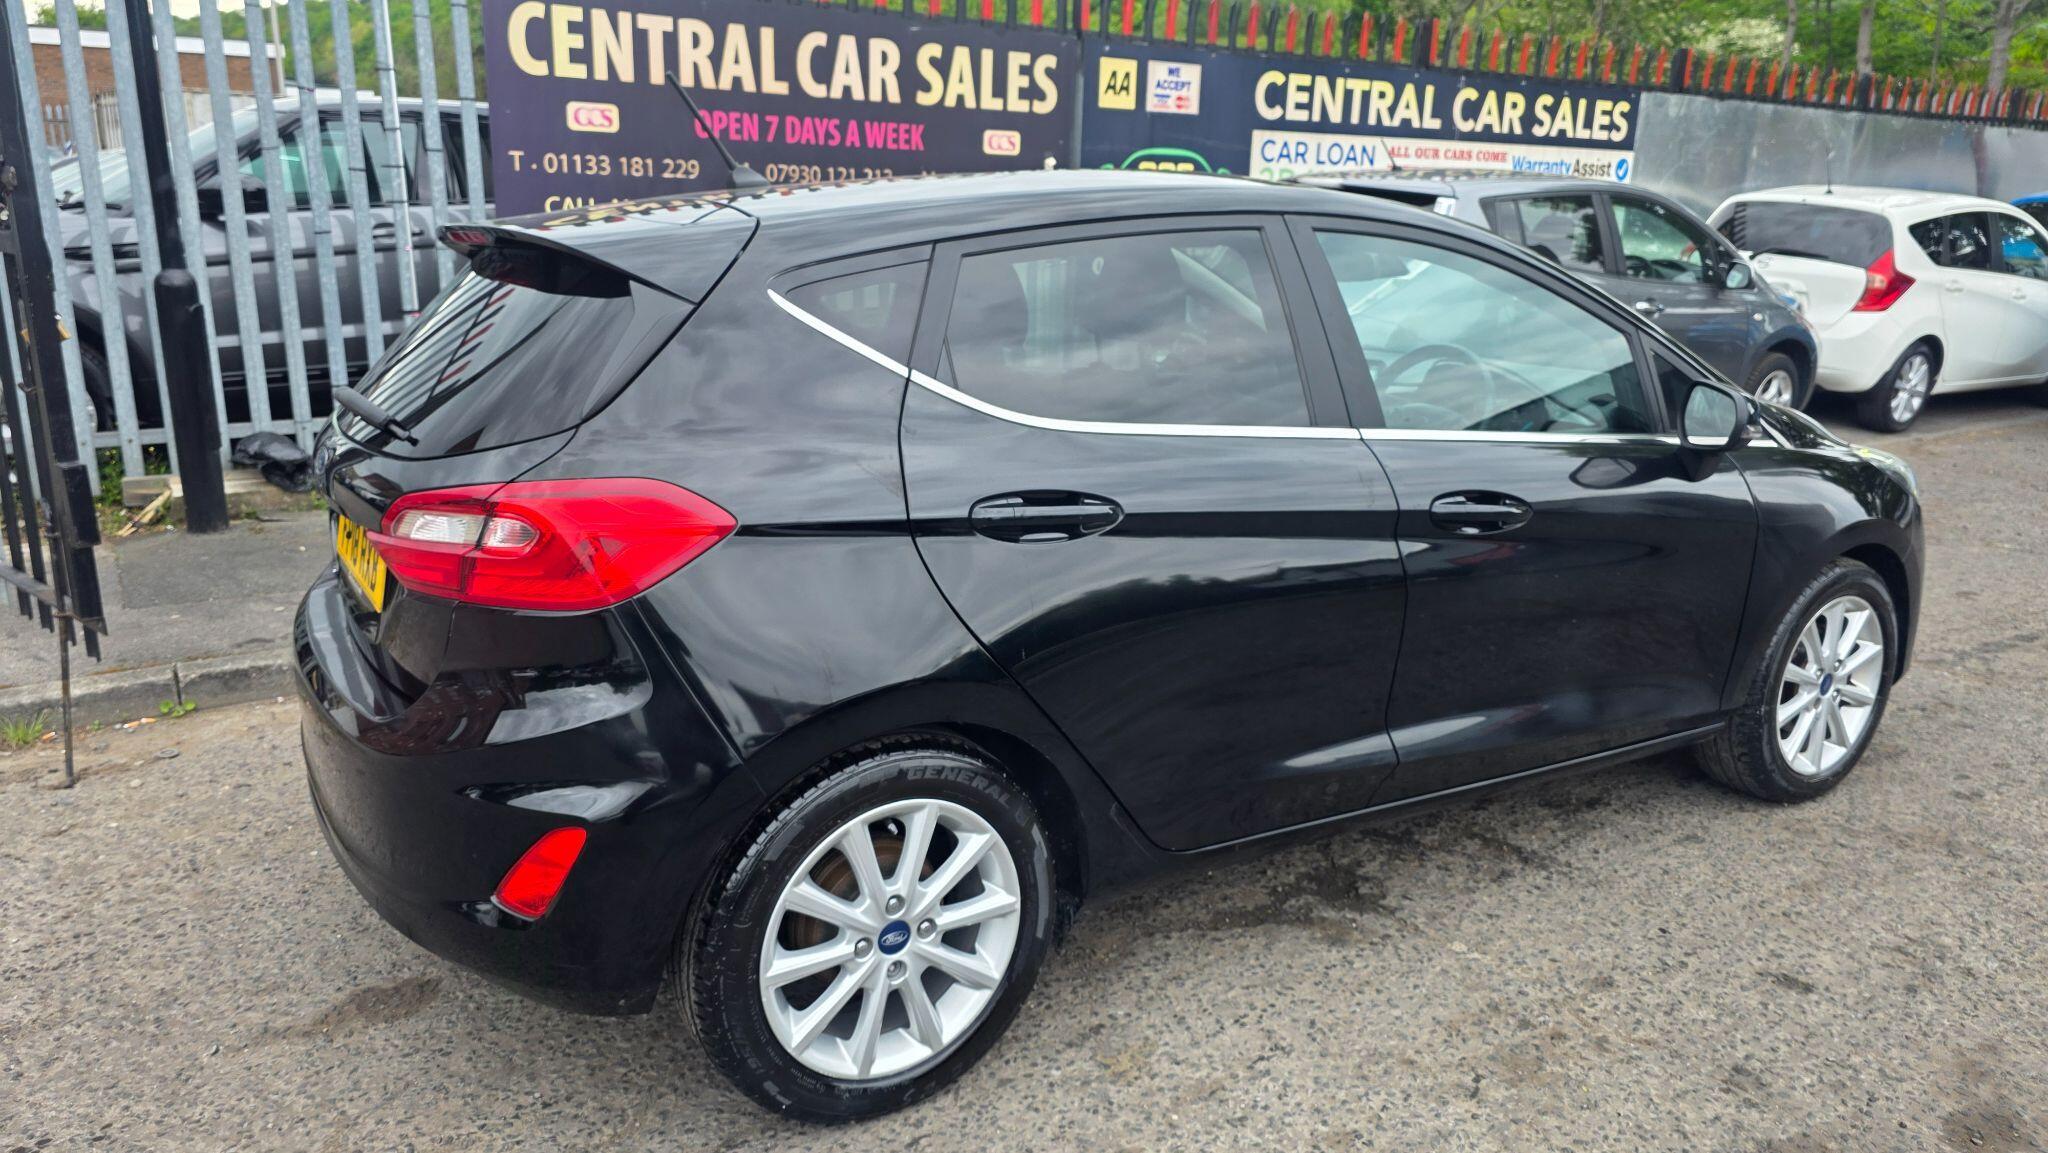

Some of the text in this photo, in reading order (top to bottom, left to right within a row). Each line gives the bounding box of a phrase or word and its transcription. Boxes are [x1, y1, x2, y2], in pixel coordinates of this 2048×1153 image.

[507, 1, 1059, 115] CENTRAL CAR SALES
[1104, 70, 1131, 96] AA
[1155, 80, 1191, 92] ACCEPT
[1254, 70, 1632, 142] CENTRAL CAR SALES
[694, 110, 925, 150] OPEN 7 DAYS A WEEK
[543, 153, 612, 176] 01133
[619, 156, 654, 178] 181
[661, 159, 701, 180] 229
[1260, 140, 1376, 167] CAR LOAN
[1389, 146, 1509, 163] ALL OUR CARS COME
[765, 163, 822, 184] 07930
[906, 764, 1011, 809] GENERAL
